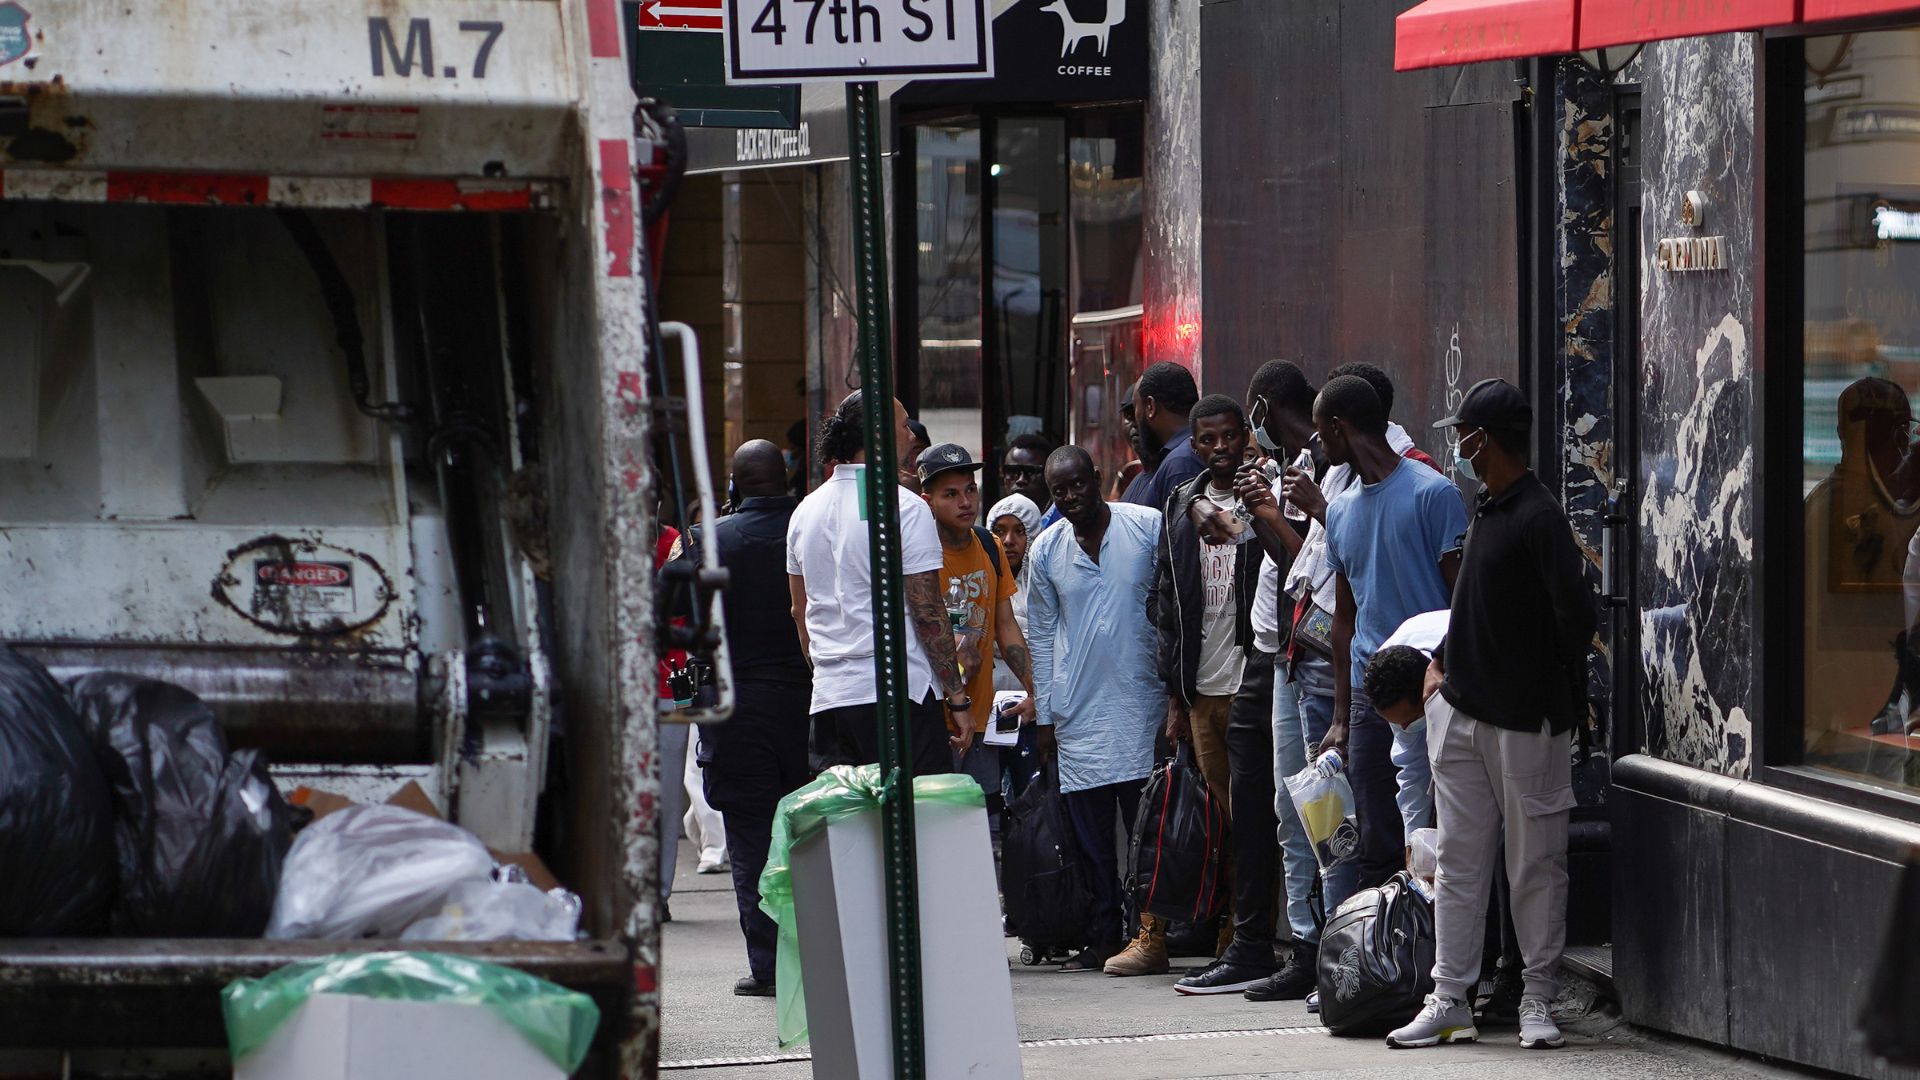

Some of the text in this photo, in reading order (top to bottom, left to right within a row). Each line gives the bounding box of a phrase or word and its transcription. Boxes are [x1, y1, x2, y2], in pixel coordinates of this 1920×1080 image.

[751, 0, 881, 45] 47th
[1439, 19, 1521, 55] CARMNA
[368, 17, 503, 78] M.7
[1057, 65, 1112, 76] COFFEE
[736, 128, 757, 161] BLACK
[757, 129, 772, 160] FOX
[772, 129, 797, 159] COFFEE
[1658, 236, 1727, 271] CARMINA
